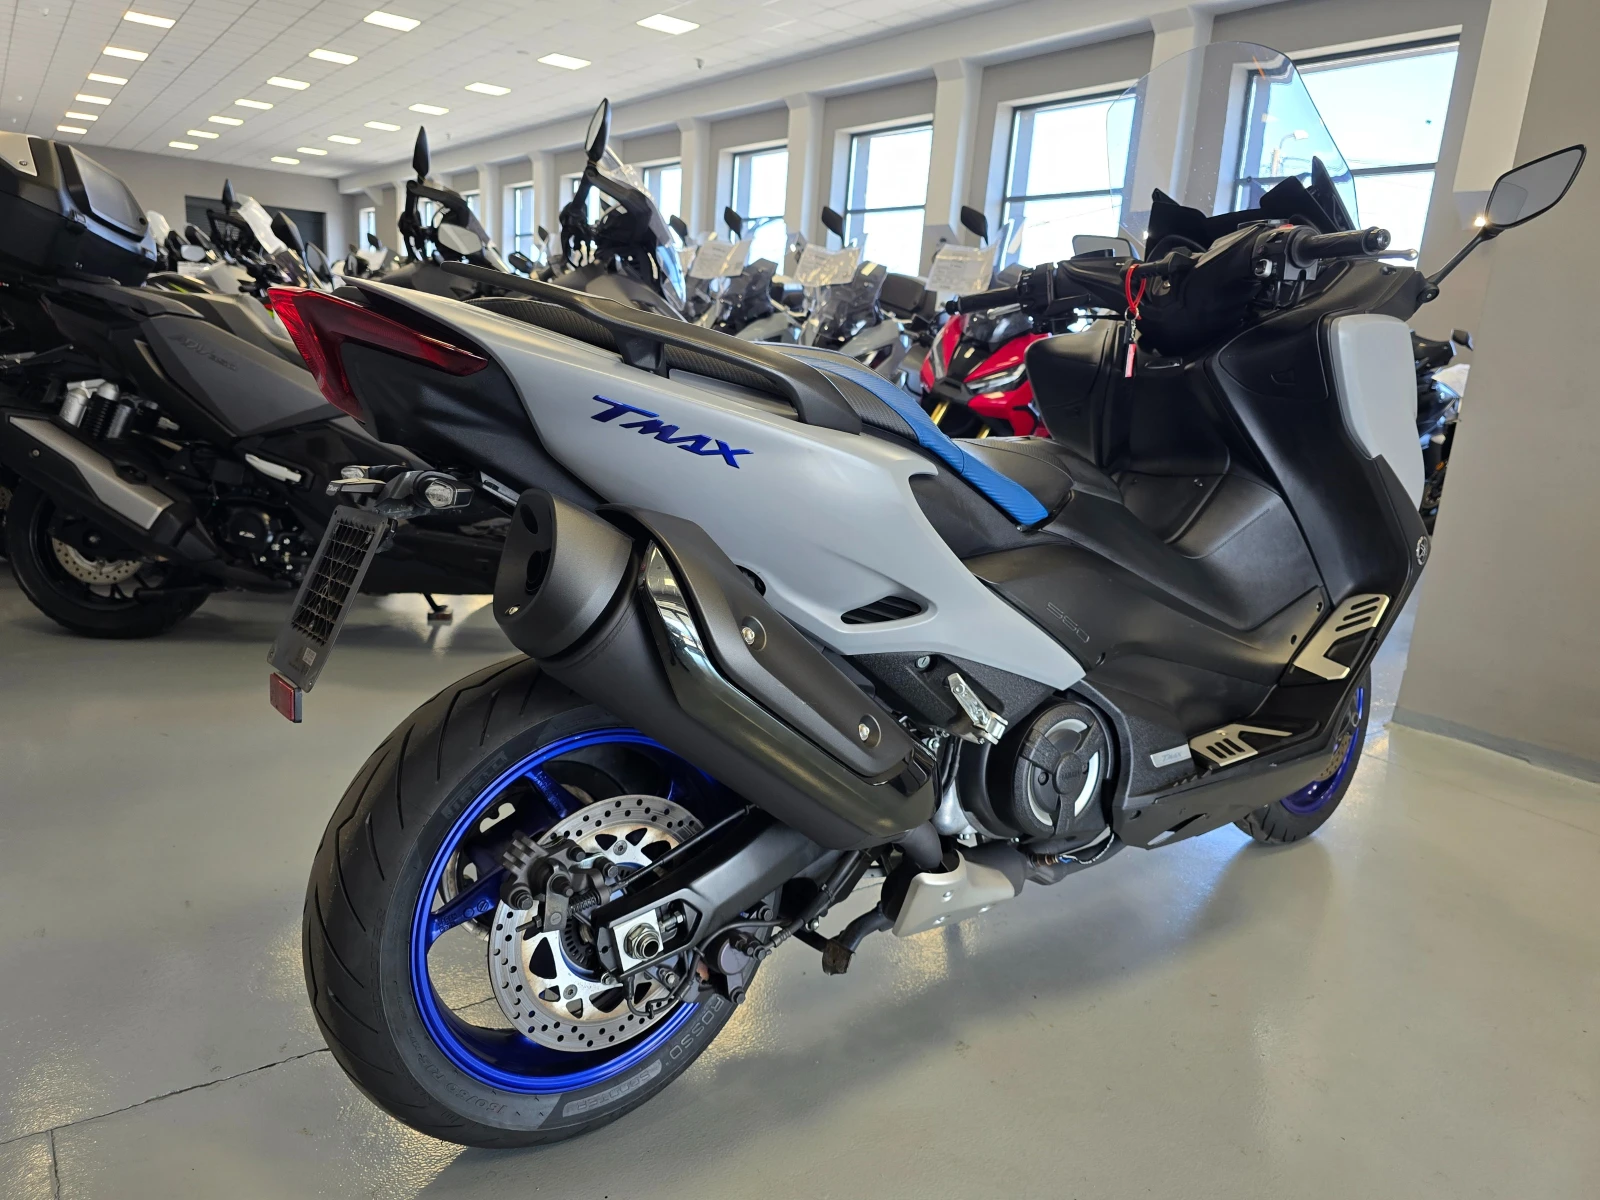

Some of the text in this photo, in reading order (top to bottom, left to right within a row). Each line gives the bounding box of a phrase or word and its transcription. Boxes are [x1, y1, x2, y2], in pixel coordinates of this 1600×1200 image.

[591, 395, 754, 469] TMAX
[669, 996, 725, 1060] ROSSO
[577, 1071, 650, 1110] SCOOTER
